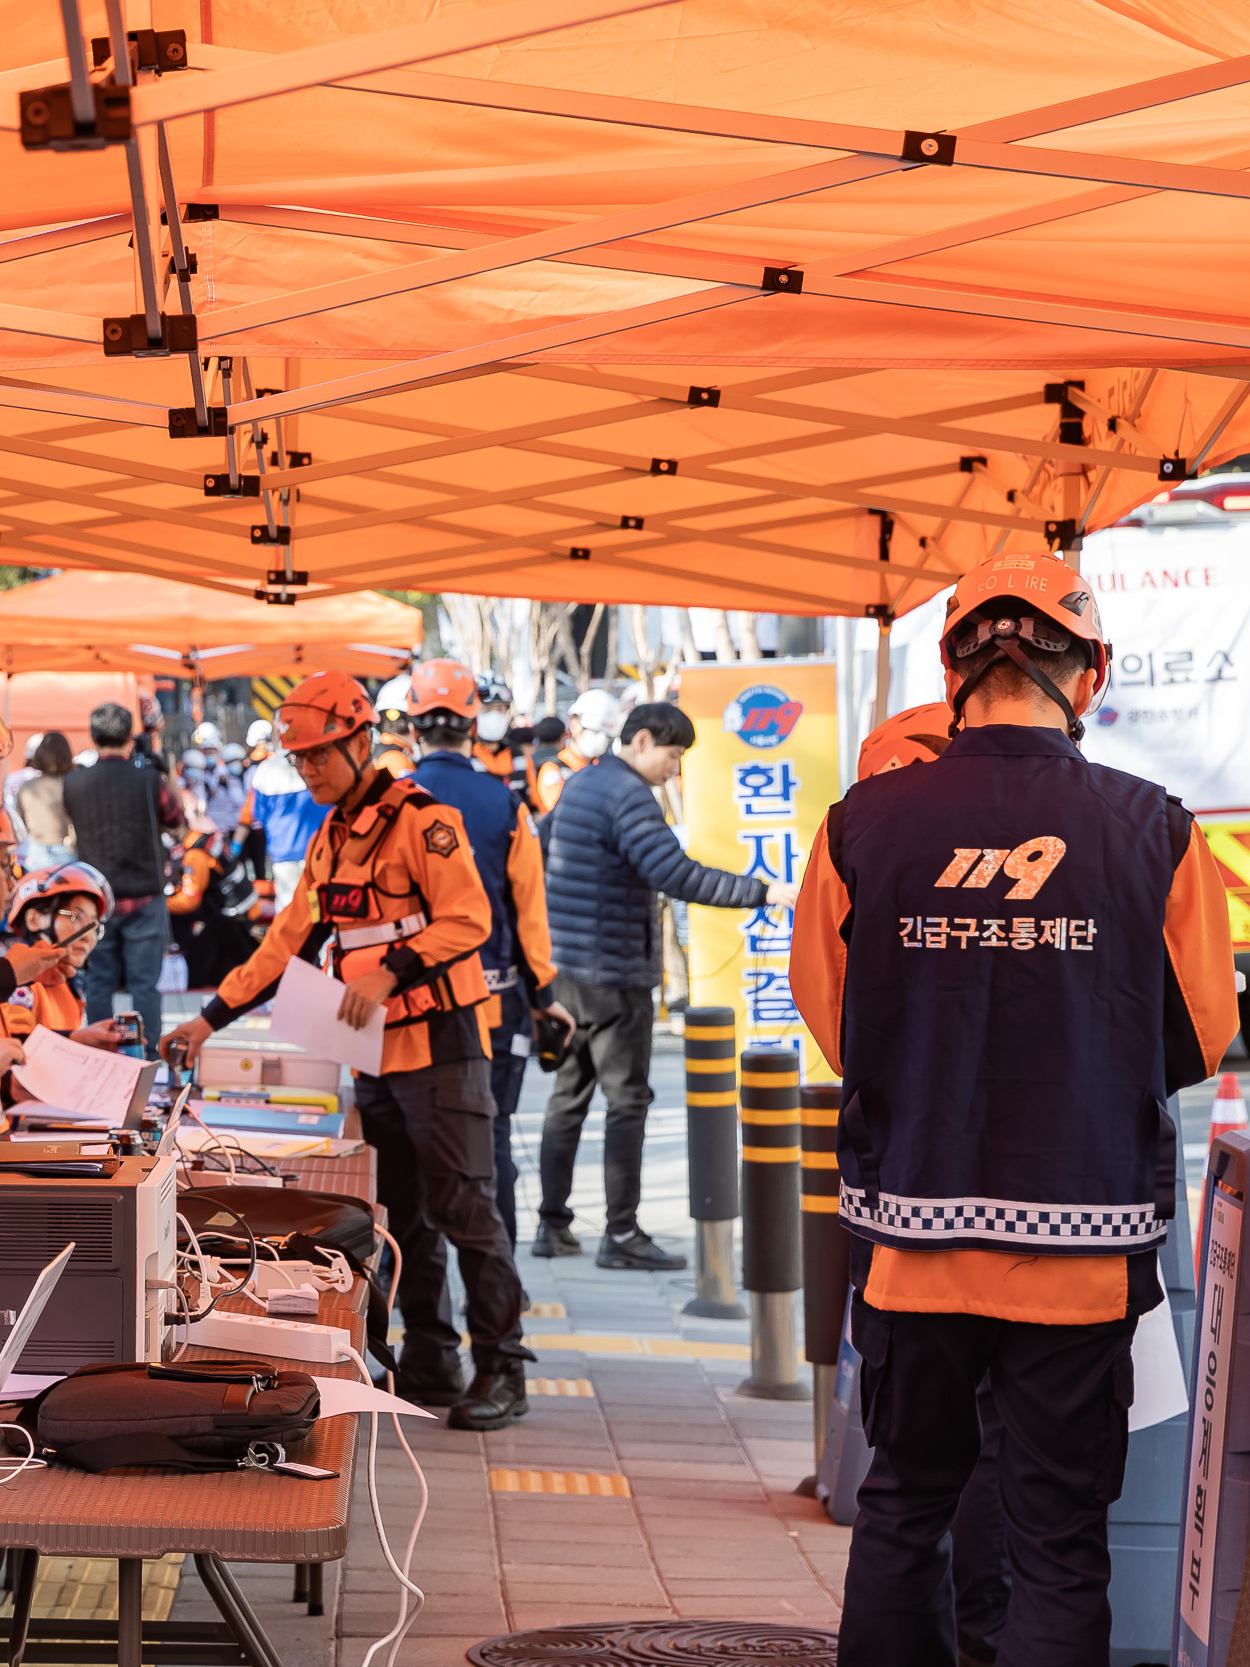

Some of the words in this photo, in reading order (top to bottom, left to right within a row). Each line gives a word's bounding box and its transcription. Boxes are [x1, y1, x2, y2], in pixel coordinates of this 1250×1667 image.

[1108, 650, 1237, 689] 의료소
[741, 701, 803, 736] 119
[934, 836, 1067, 900] 119
[331, 887, 364, 914] 119
[899, 915, 1098, 951] 긴급구조통제단
[1188, 1283, 1226, 1612] 대응계획부
